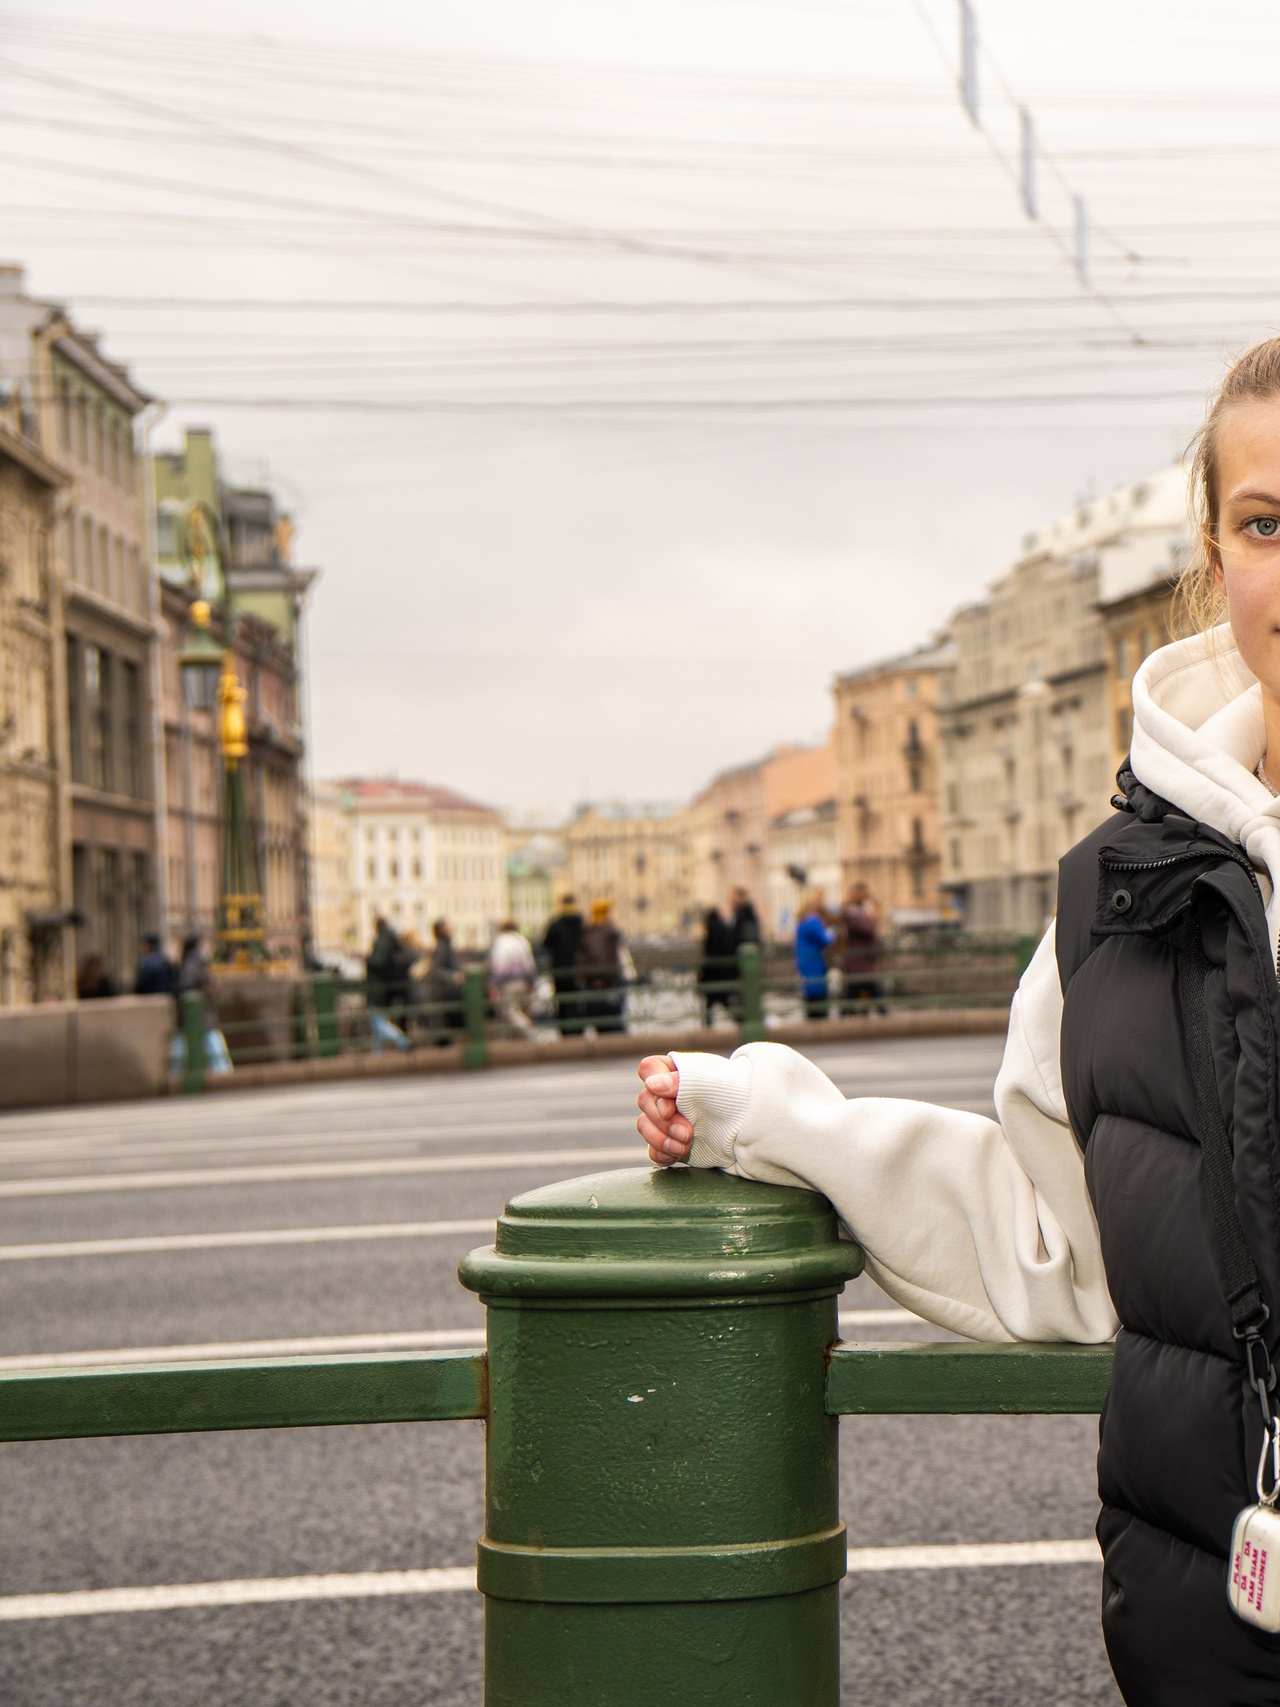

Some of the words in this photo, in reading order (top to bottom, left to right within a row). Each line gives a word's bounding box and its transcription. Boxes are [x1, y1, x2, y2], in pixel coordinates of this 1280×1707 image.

[1240, 1575, 1248, 1590] DA
[1244, 1541, 1251, 1556] DA
[1250, 1548, 1259, 1578] SIAM
[1256, 1550, 1267, 1611] MILLIONER
